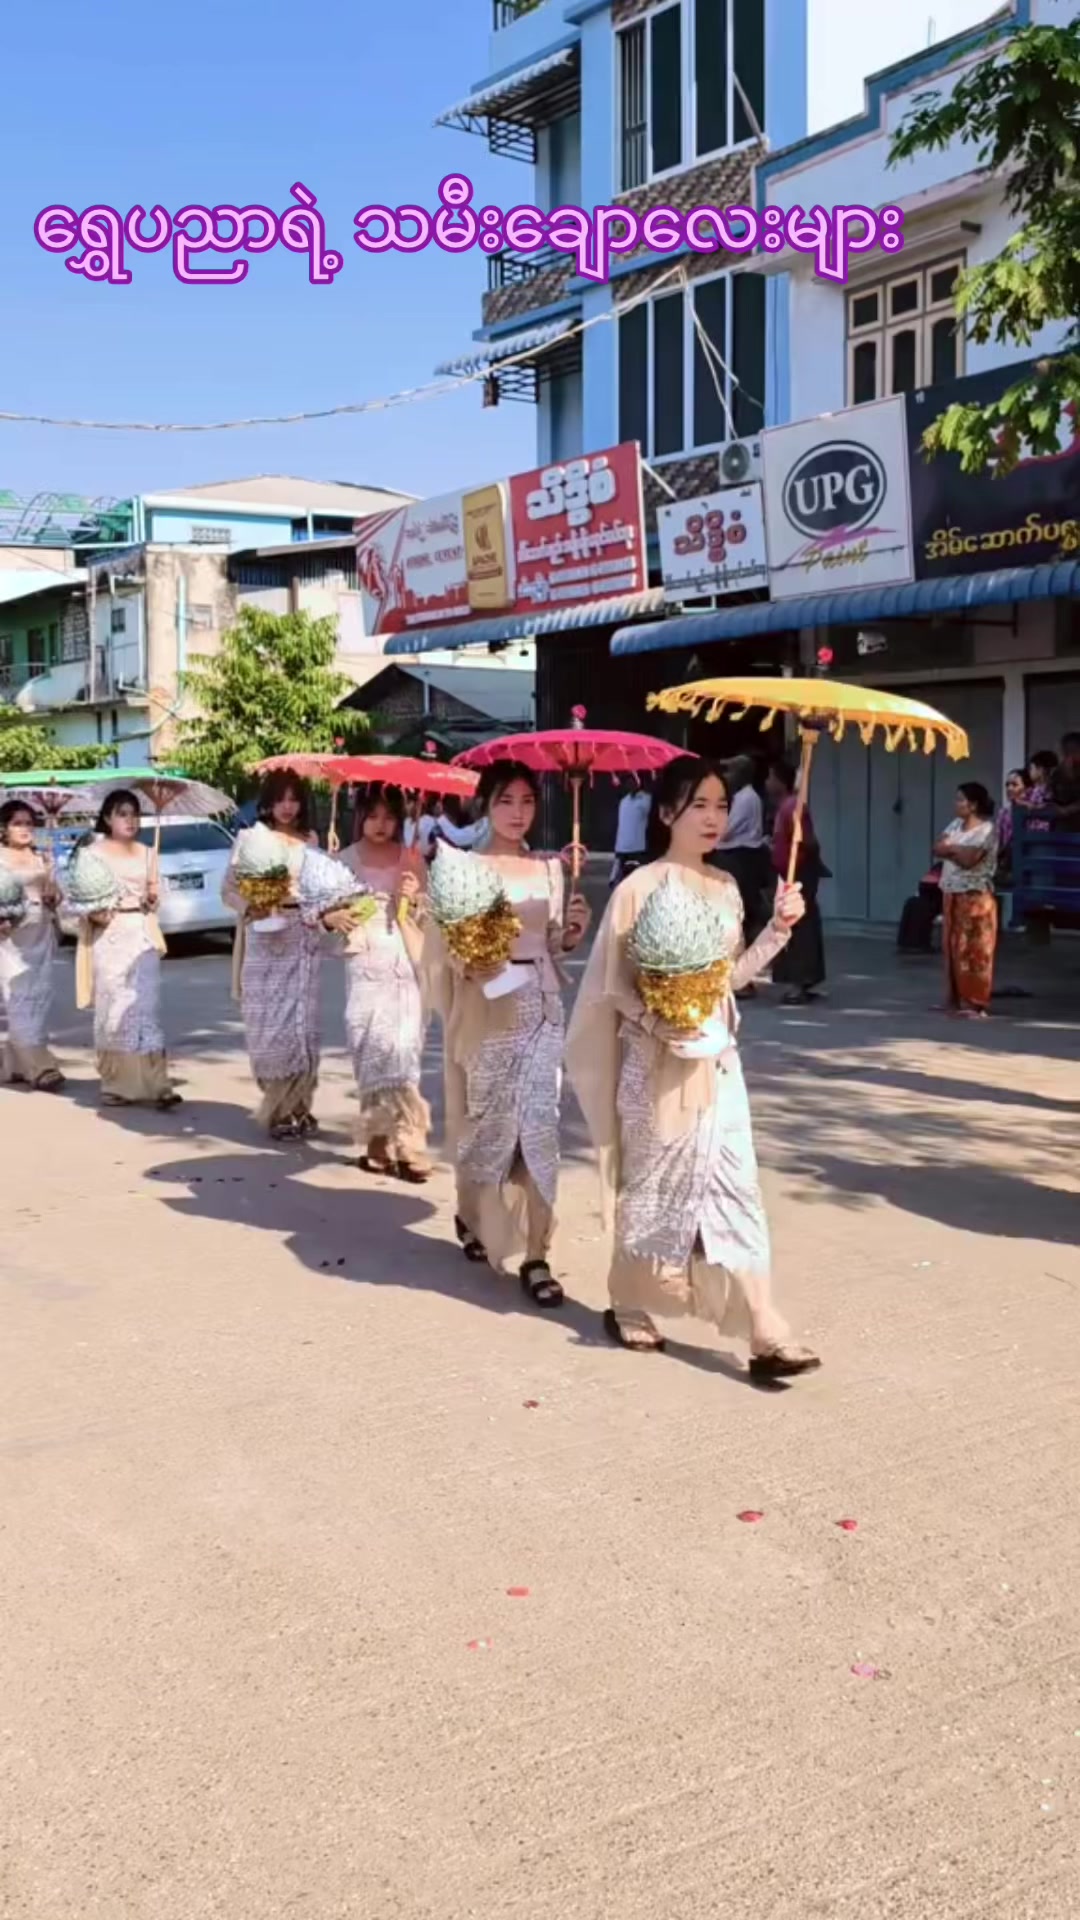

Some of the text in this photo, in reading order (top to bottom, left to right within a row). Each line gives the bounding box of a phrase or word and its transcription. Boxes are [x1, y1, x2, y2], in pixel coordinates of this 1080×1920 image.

[793, 464, 875, 515] UPG
[925, 513, 1080, 560] အိမ်ဆောက်ပစ္စ
